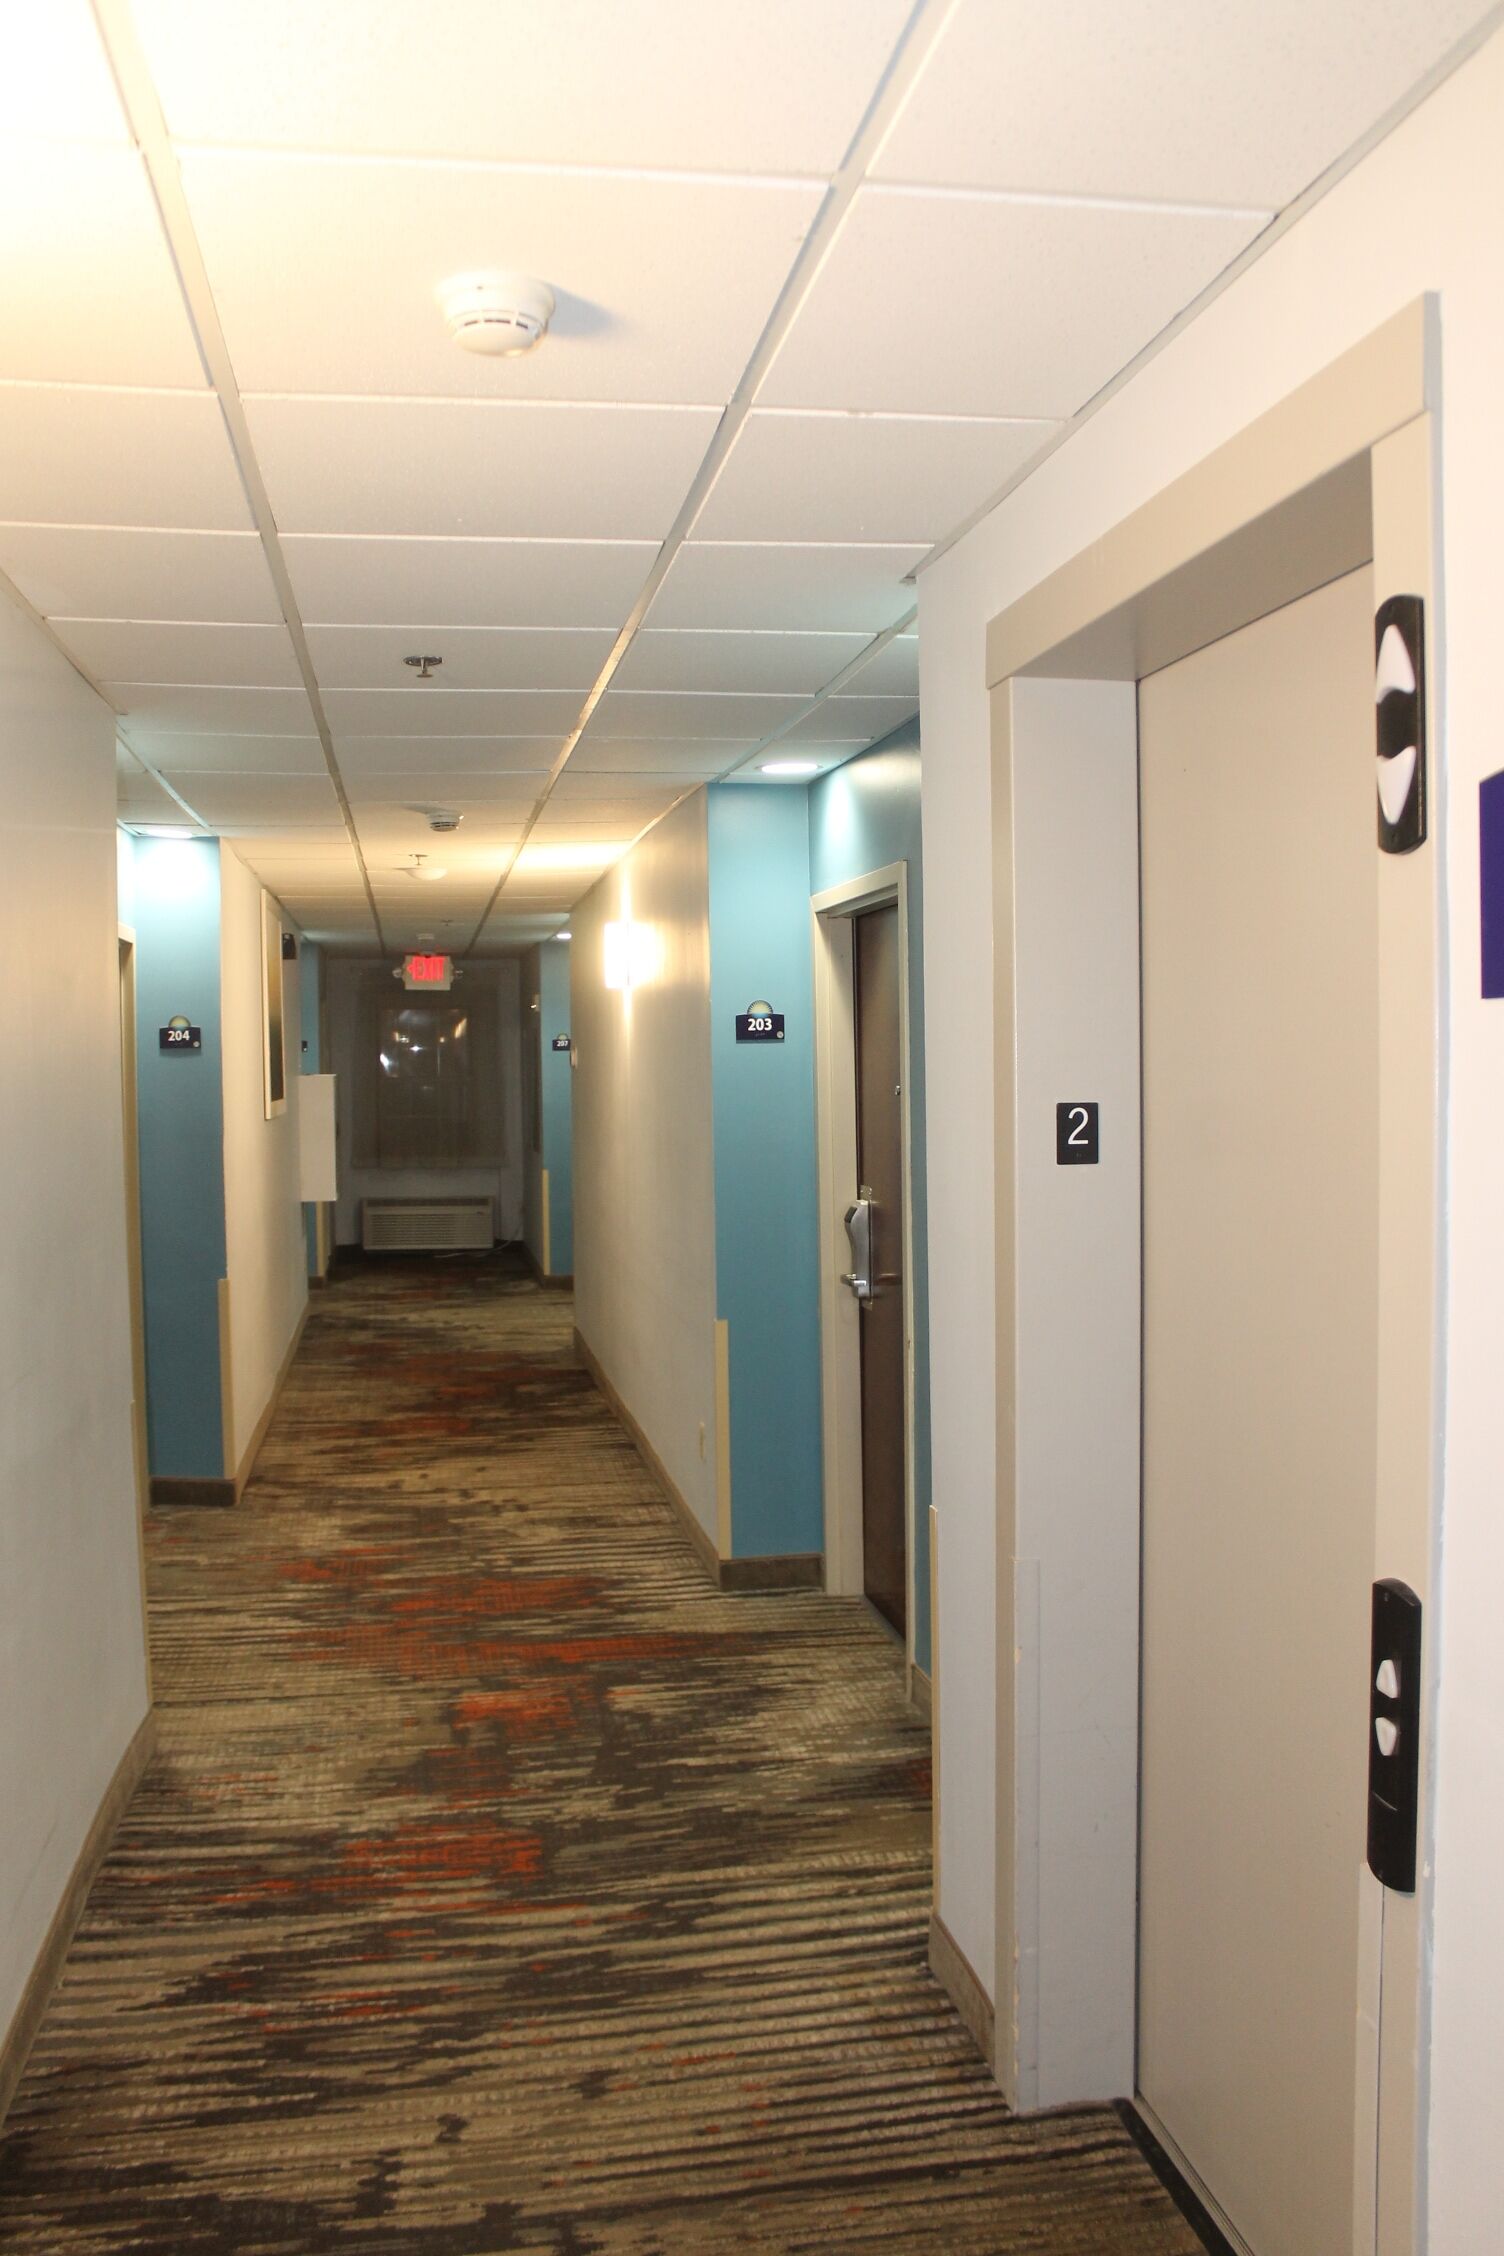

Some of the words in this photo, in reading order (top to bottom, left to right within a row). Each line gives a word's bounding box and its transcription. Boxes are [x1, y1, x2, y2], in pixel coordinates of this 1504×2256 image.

[412, 956, 444, 980] EXIT
[747, 1018, 773, 1031] 203
[167, 1030, 190, 1042] 204
[1067, 1107, 1089, 1145] 2
